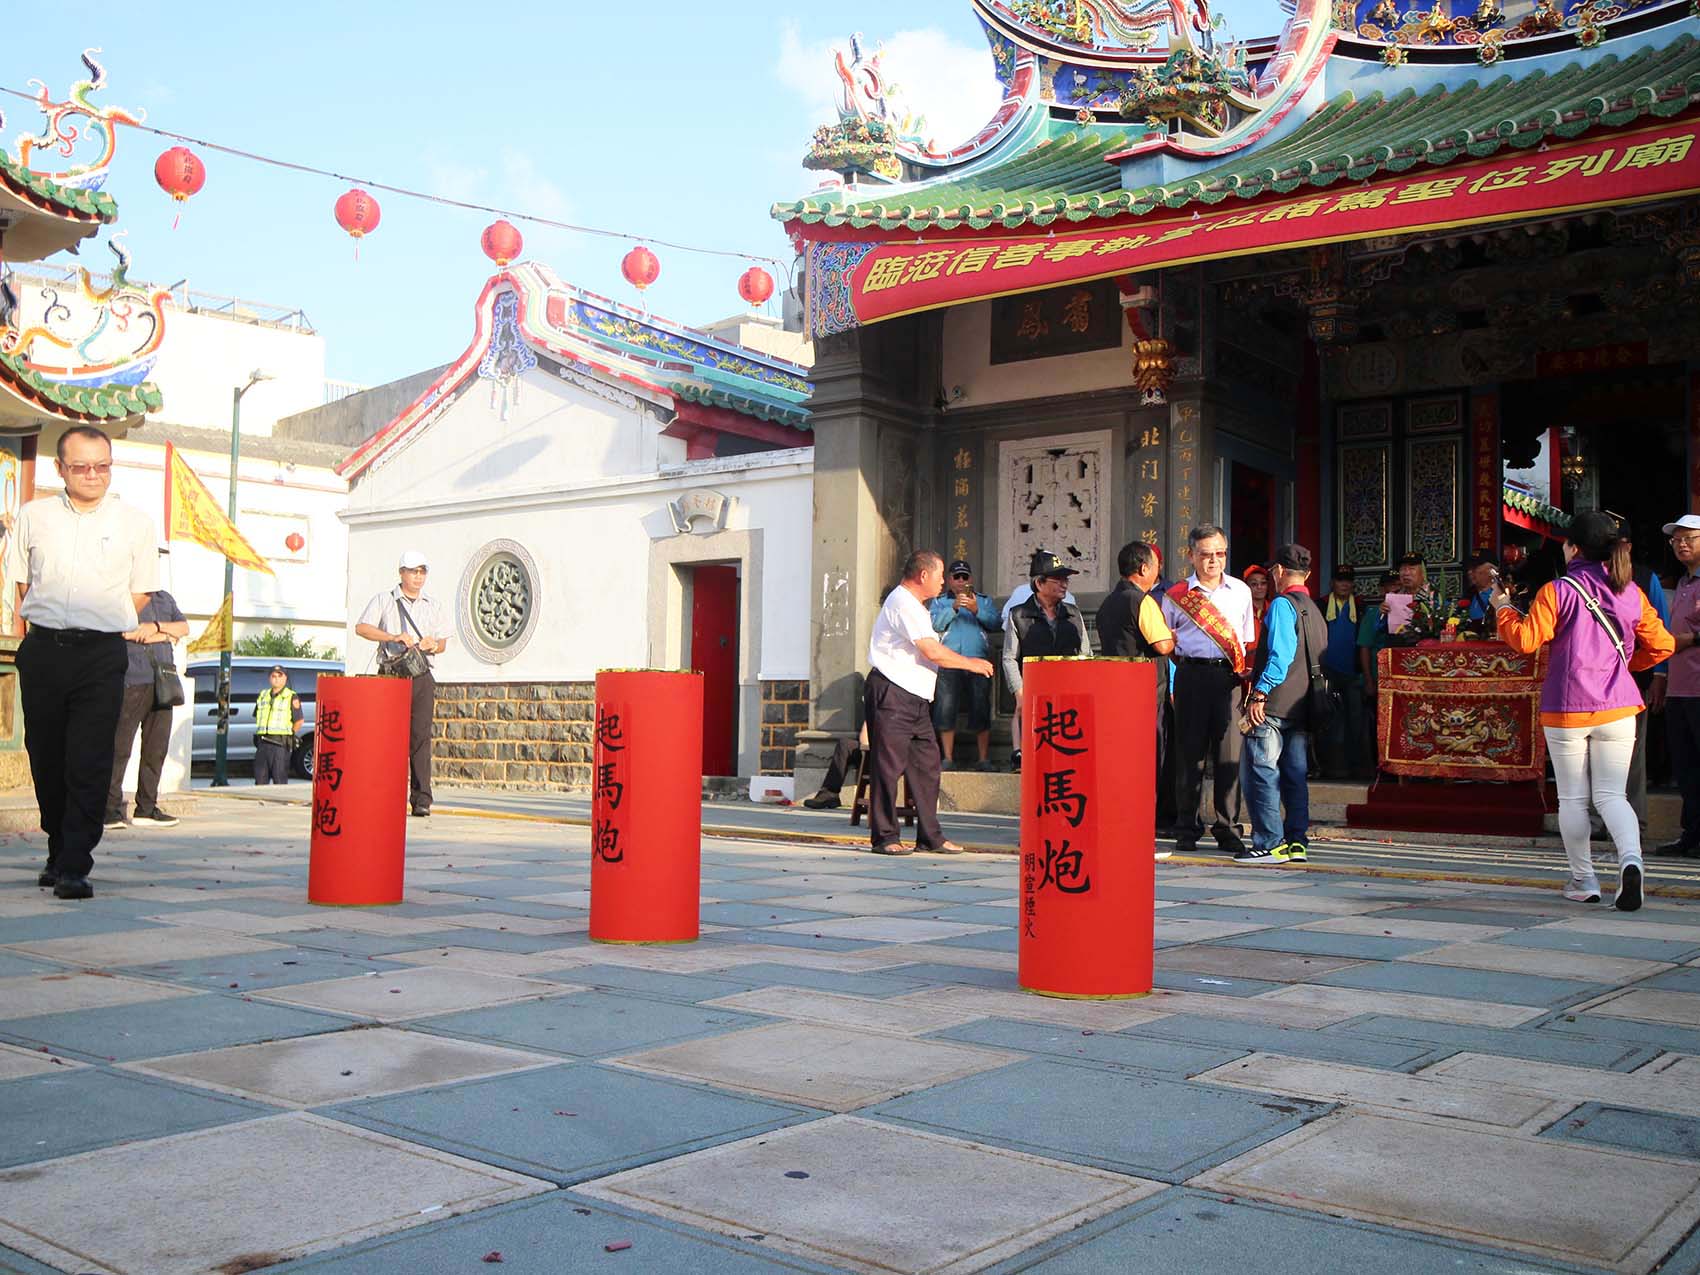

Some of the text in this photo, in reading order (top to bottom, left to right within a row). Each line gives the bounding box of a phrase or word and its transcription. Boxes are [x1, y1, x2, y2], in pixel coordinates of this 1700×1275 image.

[314, 704, 345, 836] 起馬炮
[593, 708, 625, 863] 起馬炮
[1034, 701, 1091, 894] 起馬炮
